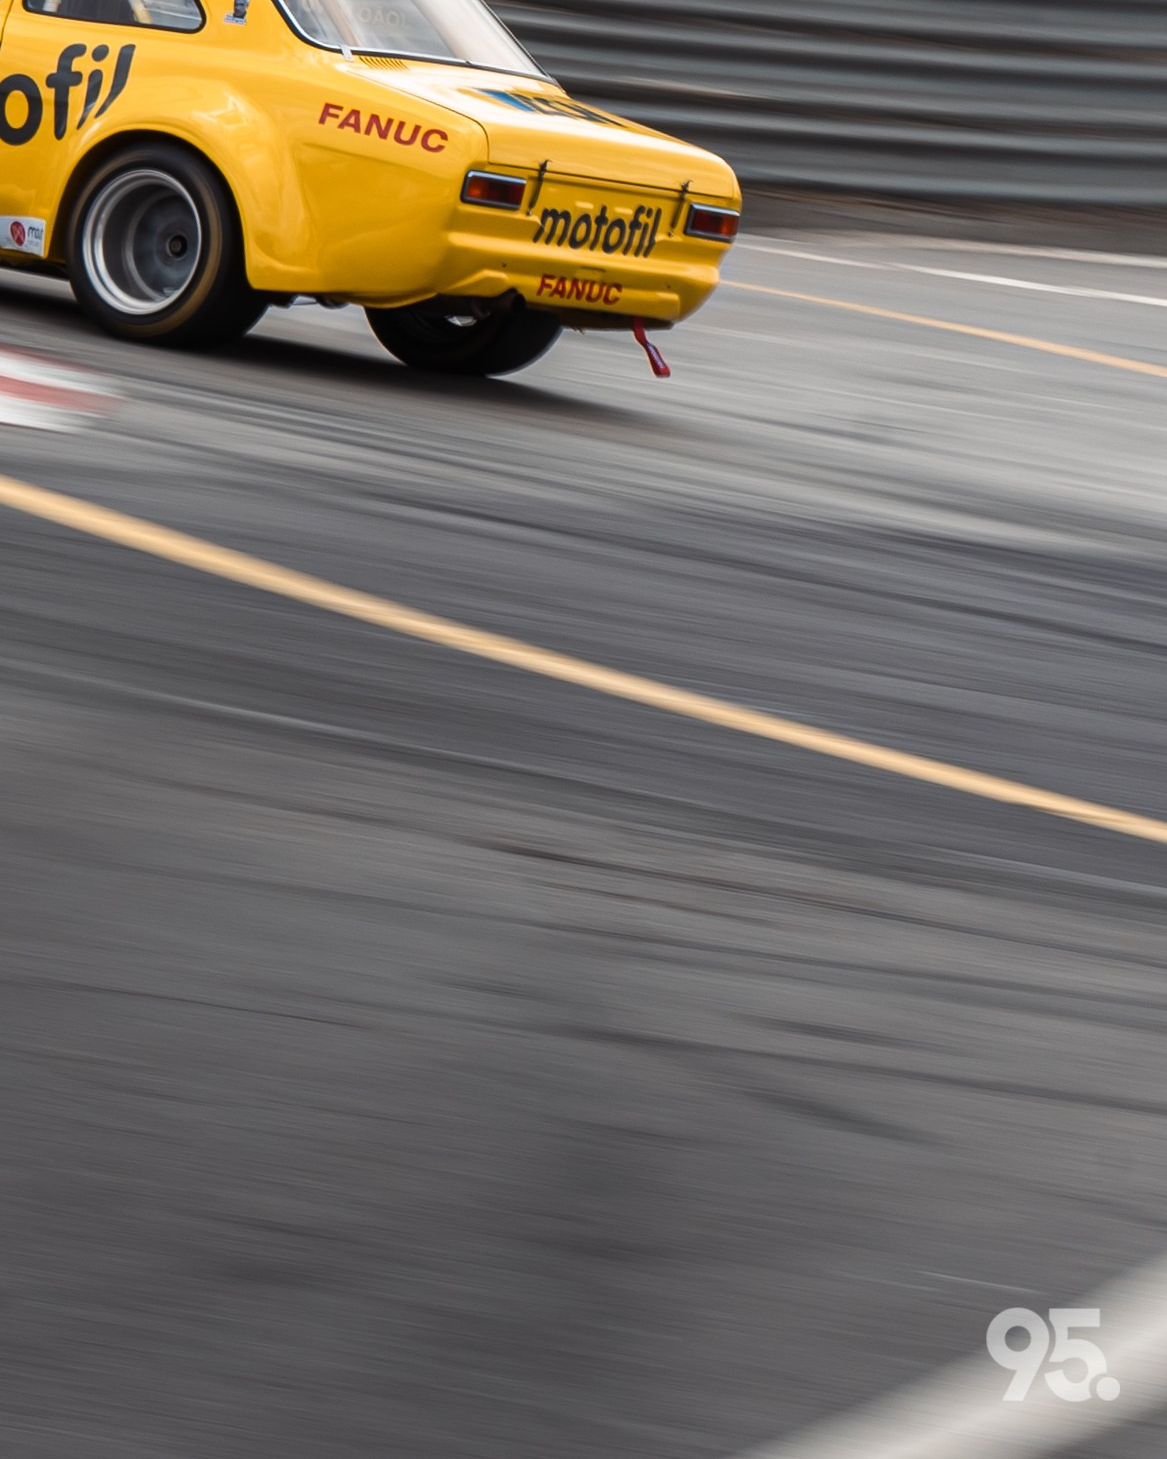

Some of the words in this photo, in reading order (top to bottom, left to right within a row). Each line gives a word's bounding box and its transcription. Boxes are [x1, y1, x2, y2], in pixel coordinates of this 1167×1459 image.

[318, 102, 449, 153] FANUC
[532, 205, 662, 259] motofil
[536, 274, 623, 306] FANUC
